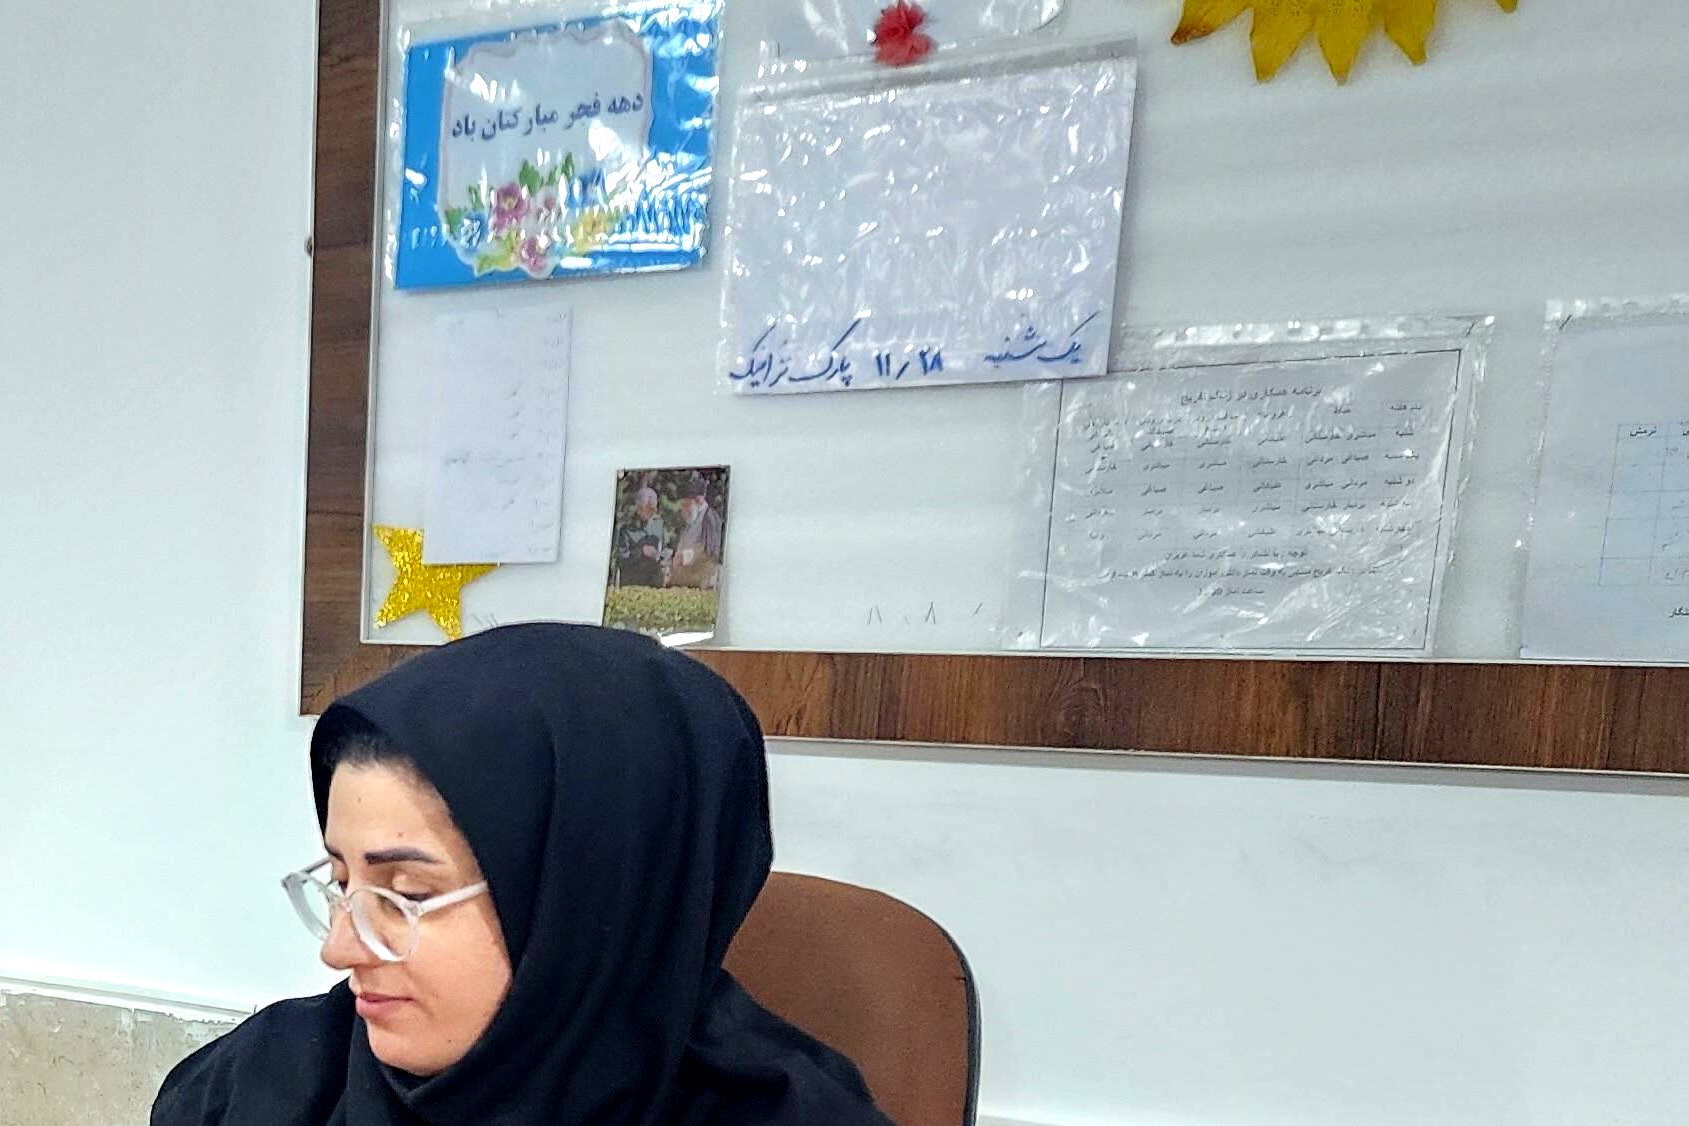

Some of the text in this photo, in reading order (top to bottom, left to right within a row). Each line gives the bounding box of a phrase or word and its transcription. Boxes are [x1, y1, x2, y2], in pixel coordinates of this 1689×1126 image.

[565, 91, 601, 130] فجر
[607, 93, 645, 115] دهه
[452, 112, 476, 142] باد
